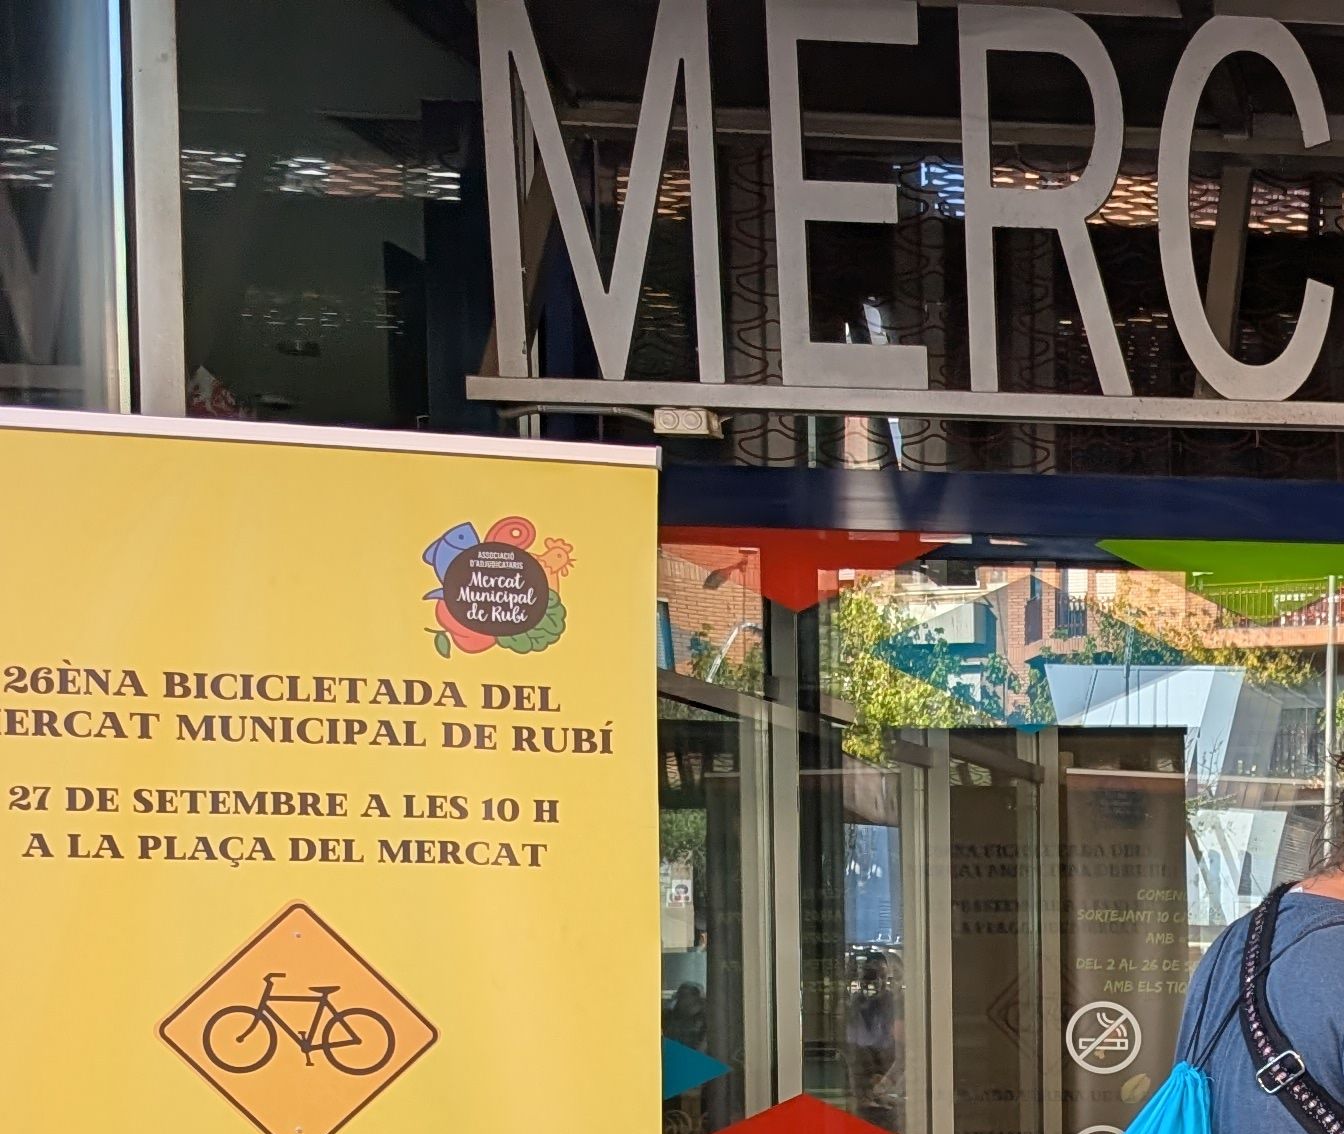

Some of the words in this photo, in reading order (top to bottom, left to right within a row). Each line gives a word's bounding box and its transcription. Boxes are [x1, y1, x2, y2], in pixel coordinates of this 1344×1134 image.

[469, 572, 525, 589] Mercat
[456, 587, 537, 609] Municipal
[467, 604, 488, 621] de
[4, 660, 147, 696] 26ÈNA
[163, 672, 466, 707] BICICLETADA
[482, 684, 560, 712] DEL
[0, 709, 159, 739] ERCAT
[177, 715, 426, 746] MUNICIPAL
[442, 722, 496, 749] DE
[512, 721, 612, 753] RUBÍ
[9, 786, 50, 810] 27
[66, 787, 118, 812] DE
[134, 789, 347, 816] SETEMBRE
[361, 794, 390, 817] A
[404, 795, 468, 819] LES
[483, 799, 519, 821] 10
[534, 800, 558, 823] H
[23, 834, 53, 857] A
[68, 834, 124, 858] LA
[138, 836, 275, 867] PLAÇA
[289, 838, 364, 862] DEL
[378, 840, 547, 866] MERCAT
[1077, 909, 1152, 922] SORTEJANT
[1145, 933, 1175, 944] AMB
[1076, 959, 1103, 970] DEL
[1107, 959, 1116, 970] 2
[1119, 959, 1138, 970] AL
[1141, 960, 1159, 970] 26
[1162, 960, 1180, 971] DE
[1104, 980, 1133, 993] AMB
[1138, 981, 1163, 993] ELS
